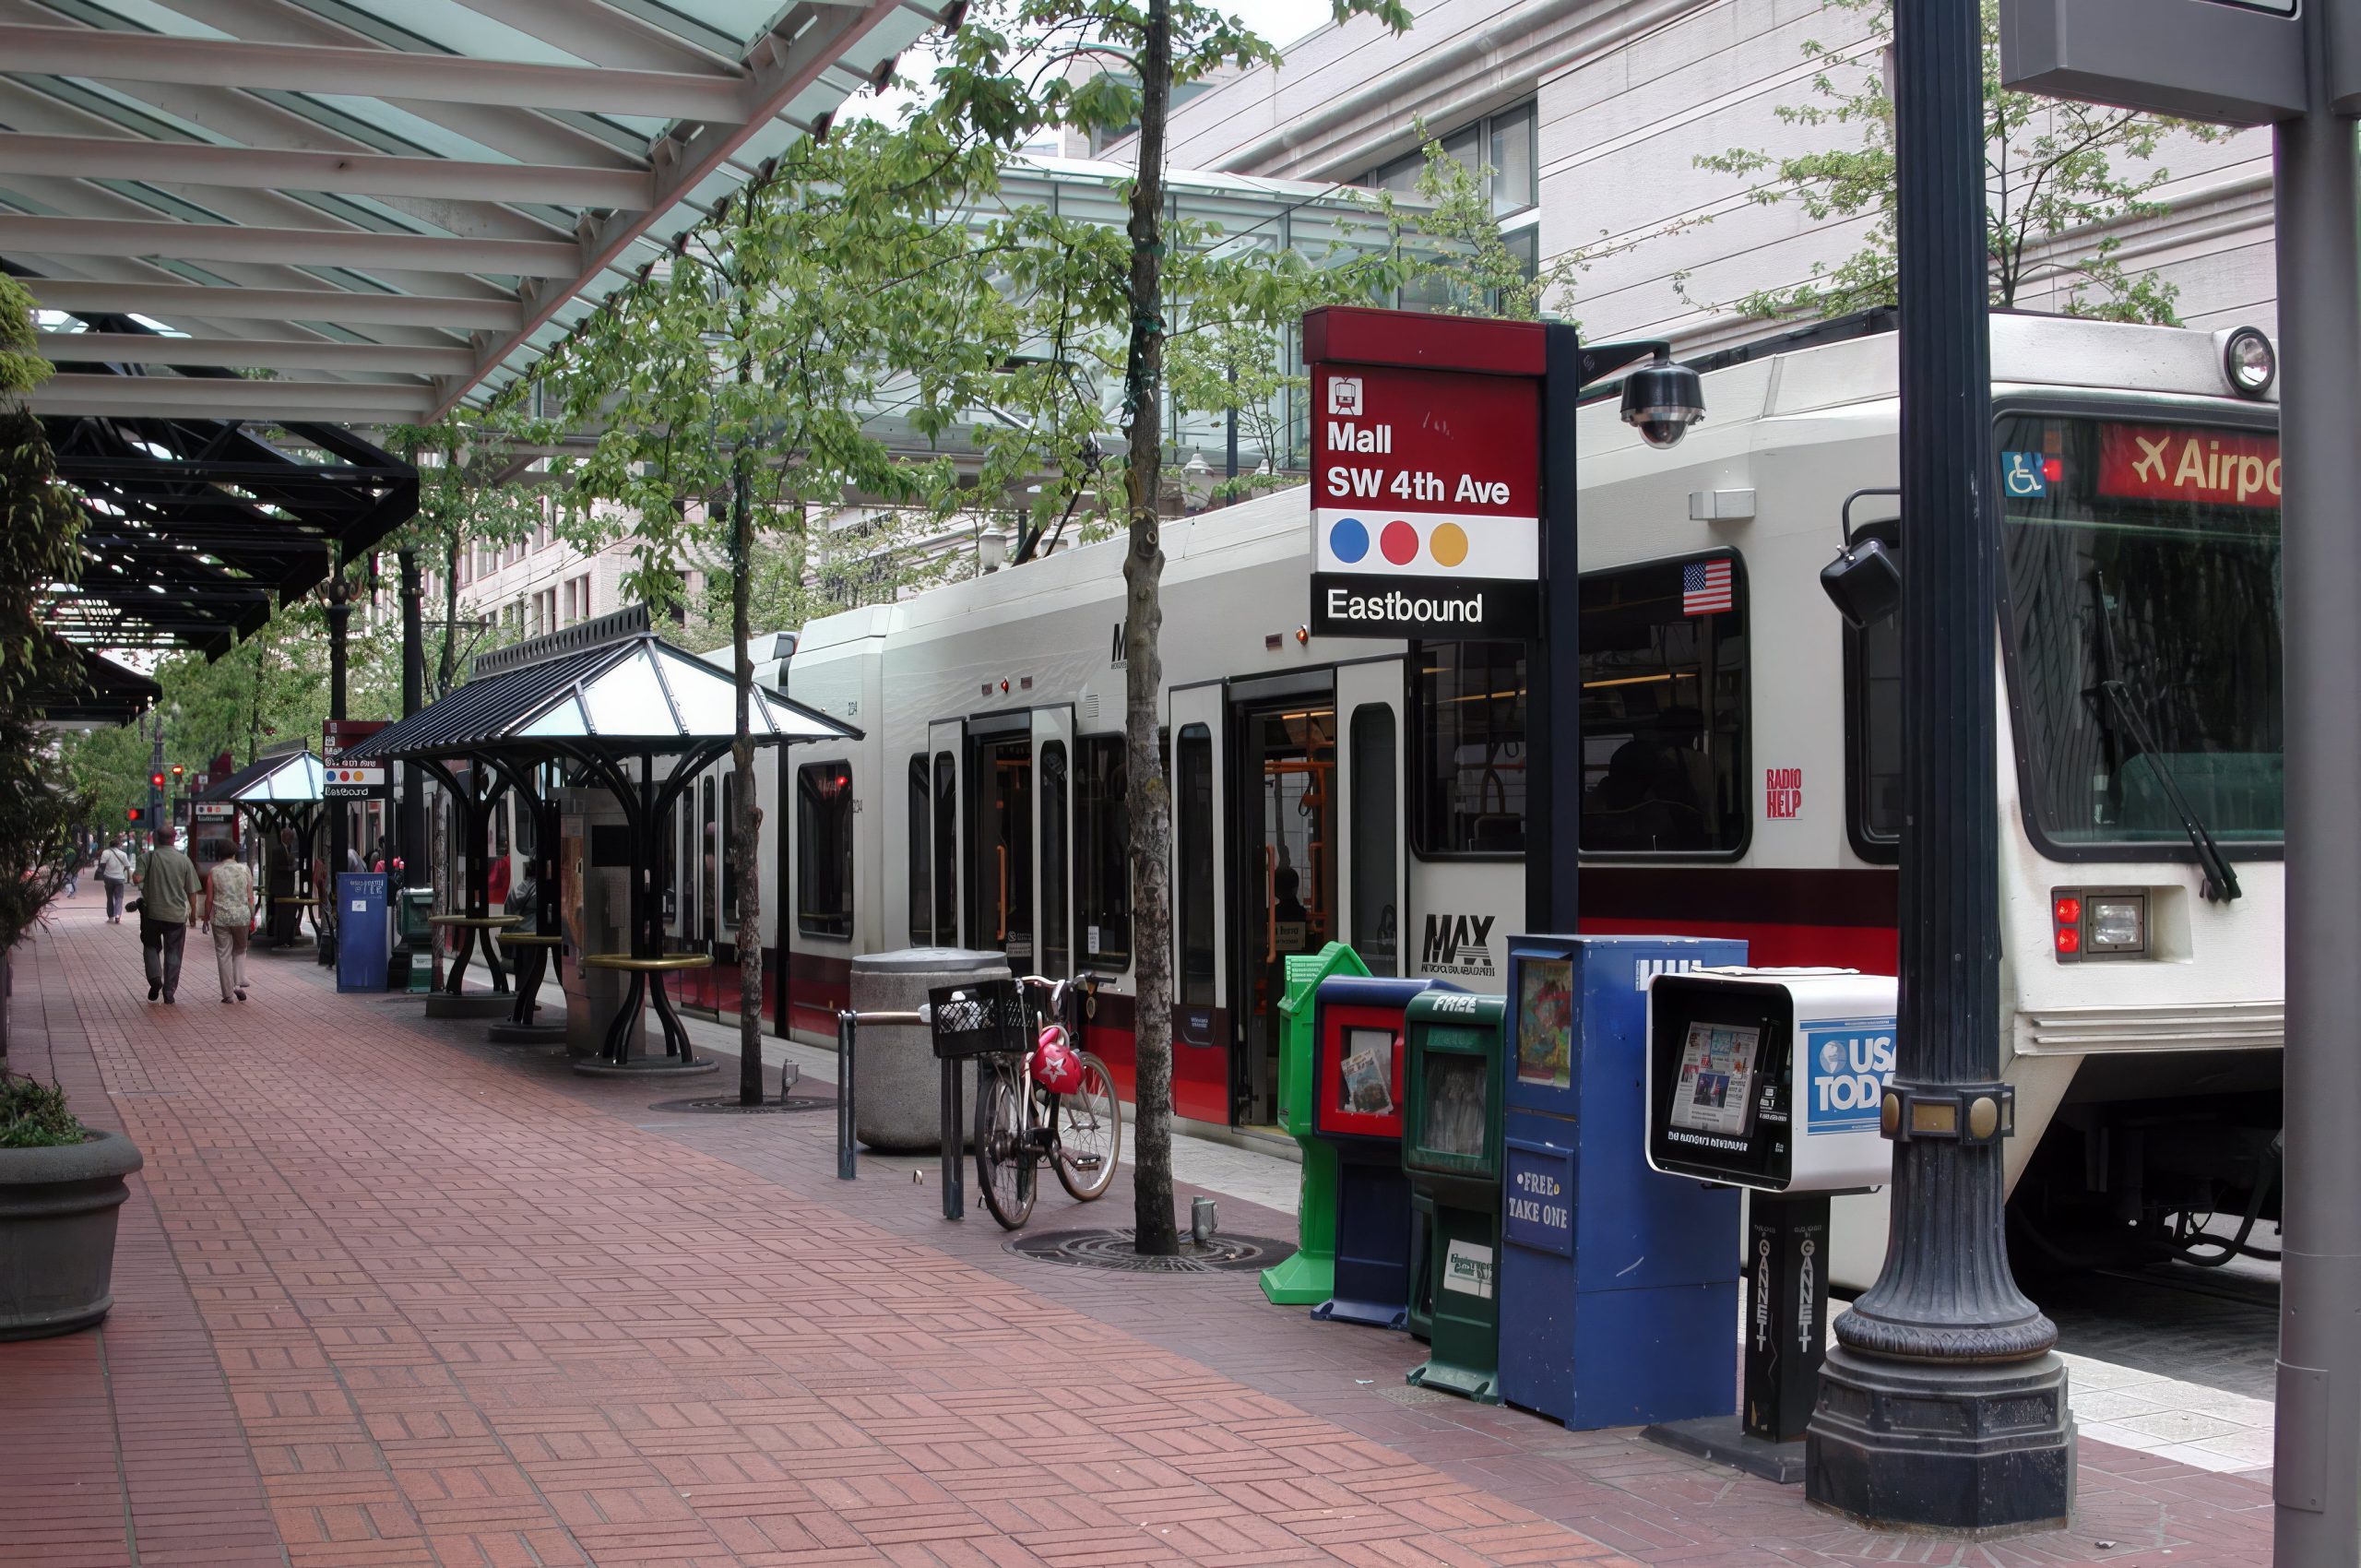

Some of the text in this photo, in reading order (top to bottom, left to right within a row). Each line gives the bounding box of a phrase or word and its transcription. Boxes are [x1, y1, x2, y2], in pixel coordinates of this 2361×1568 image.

[1328, 422, 1392, 455] Mall
[1328, 467, 1511, 505] SW 4th Ave
[1328, 589, 1483, 624] Eastbound
[1766, 768, 1802, 790] RADIO
[1766, 790, 1802, 819] HELP
[1422, 913, 1496, 967] MAX
[1432, 995, 1477, 1014] FREE
[1524, 1171, 1554, 1196] FREE
[1509, 1197, 1568, 1229] TAKE ONE
[1756, 1239, 1771, 1352] GANNETT
[1798, 1239, 1816, 1353] GANNETT
